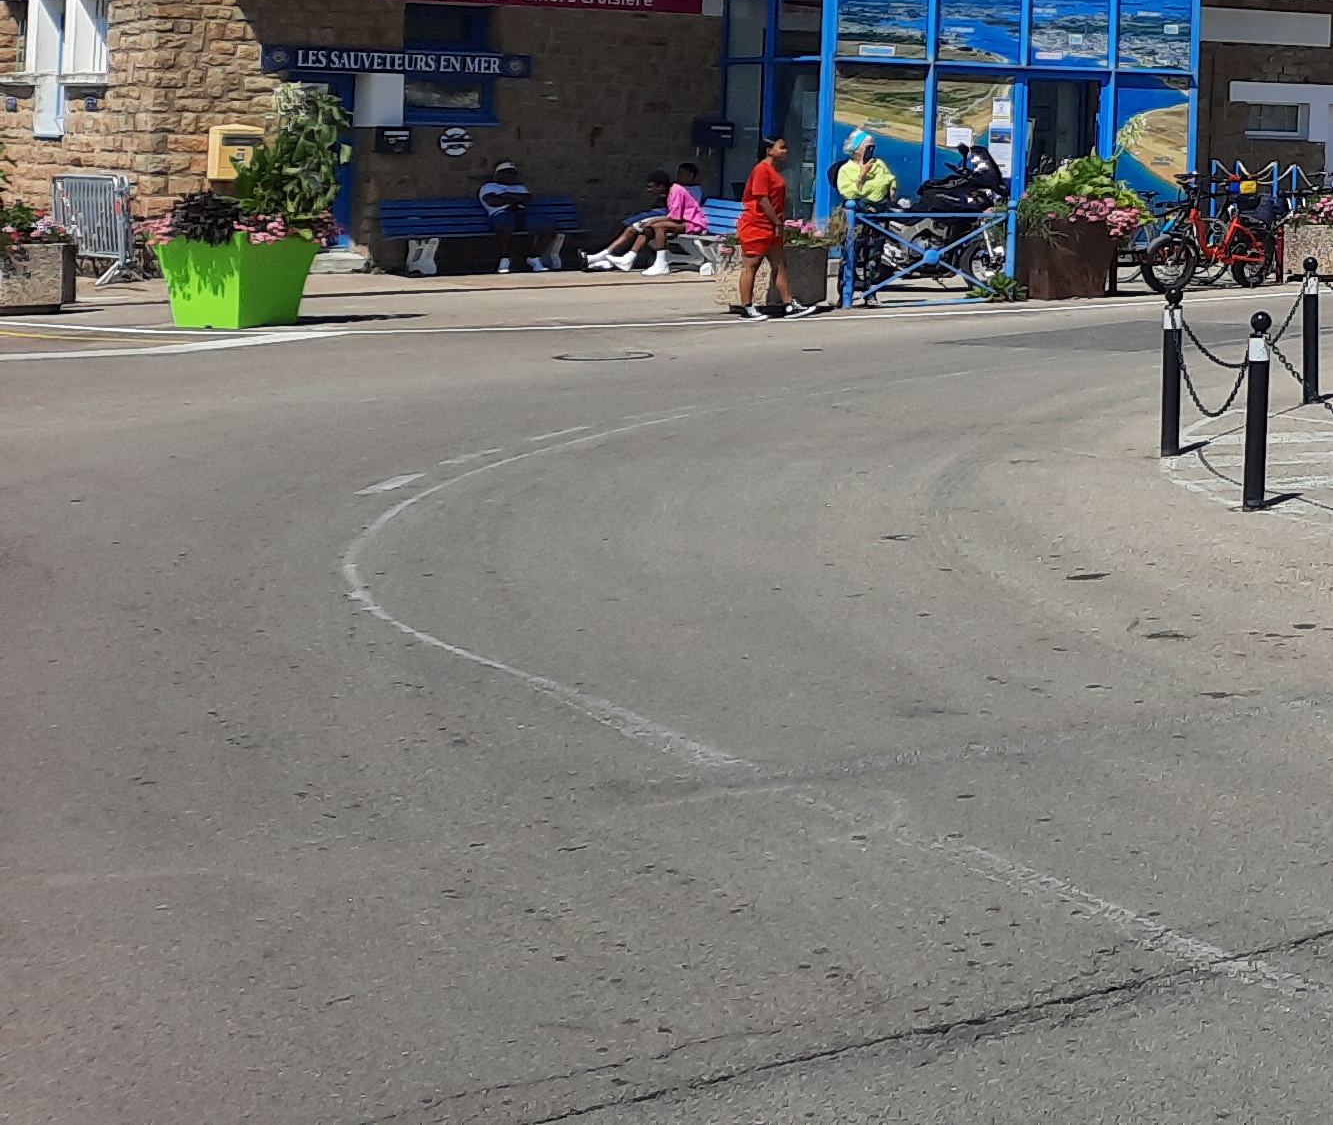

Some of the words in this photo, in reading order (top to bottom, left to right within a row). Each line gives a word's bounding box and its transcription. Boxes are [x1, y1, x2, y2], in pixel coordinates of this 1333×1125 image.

[297, 49, 326, 68] LES
[330, 51, 436, 73] SAUVETEURS
[439, 57, 463, 73] EN
[464, 56, 502, 74] MER
